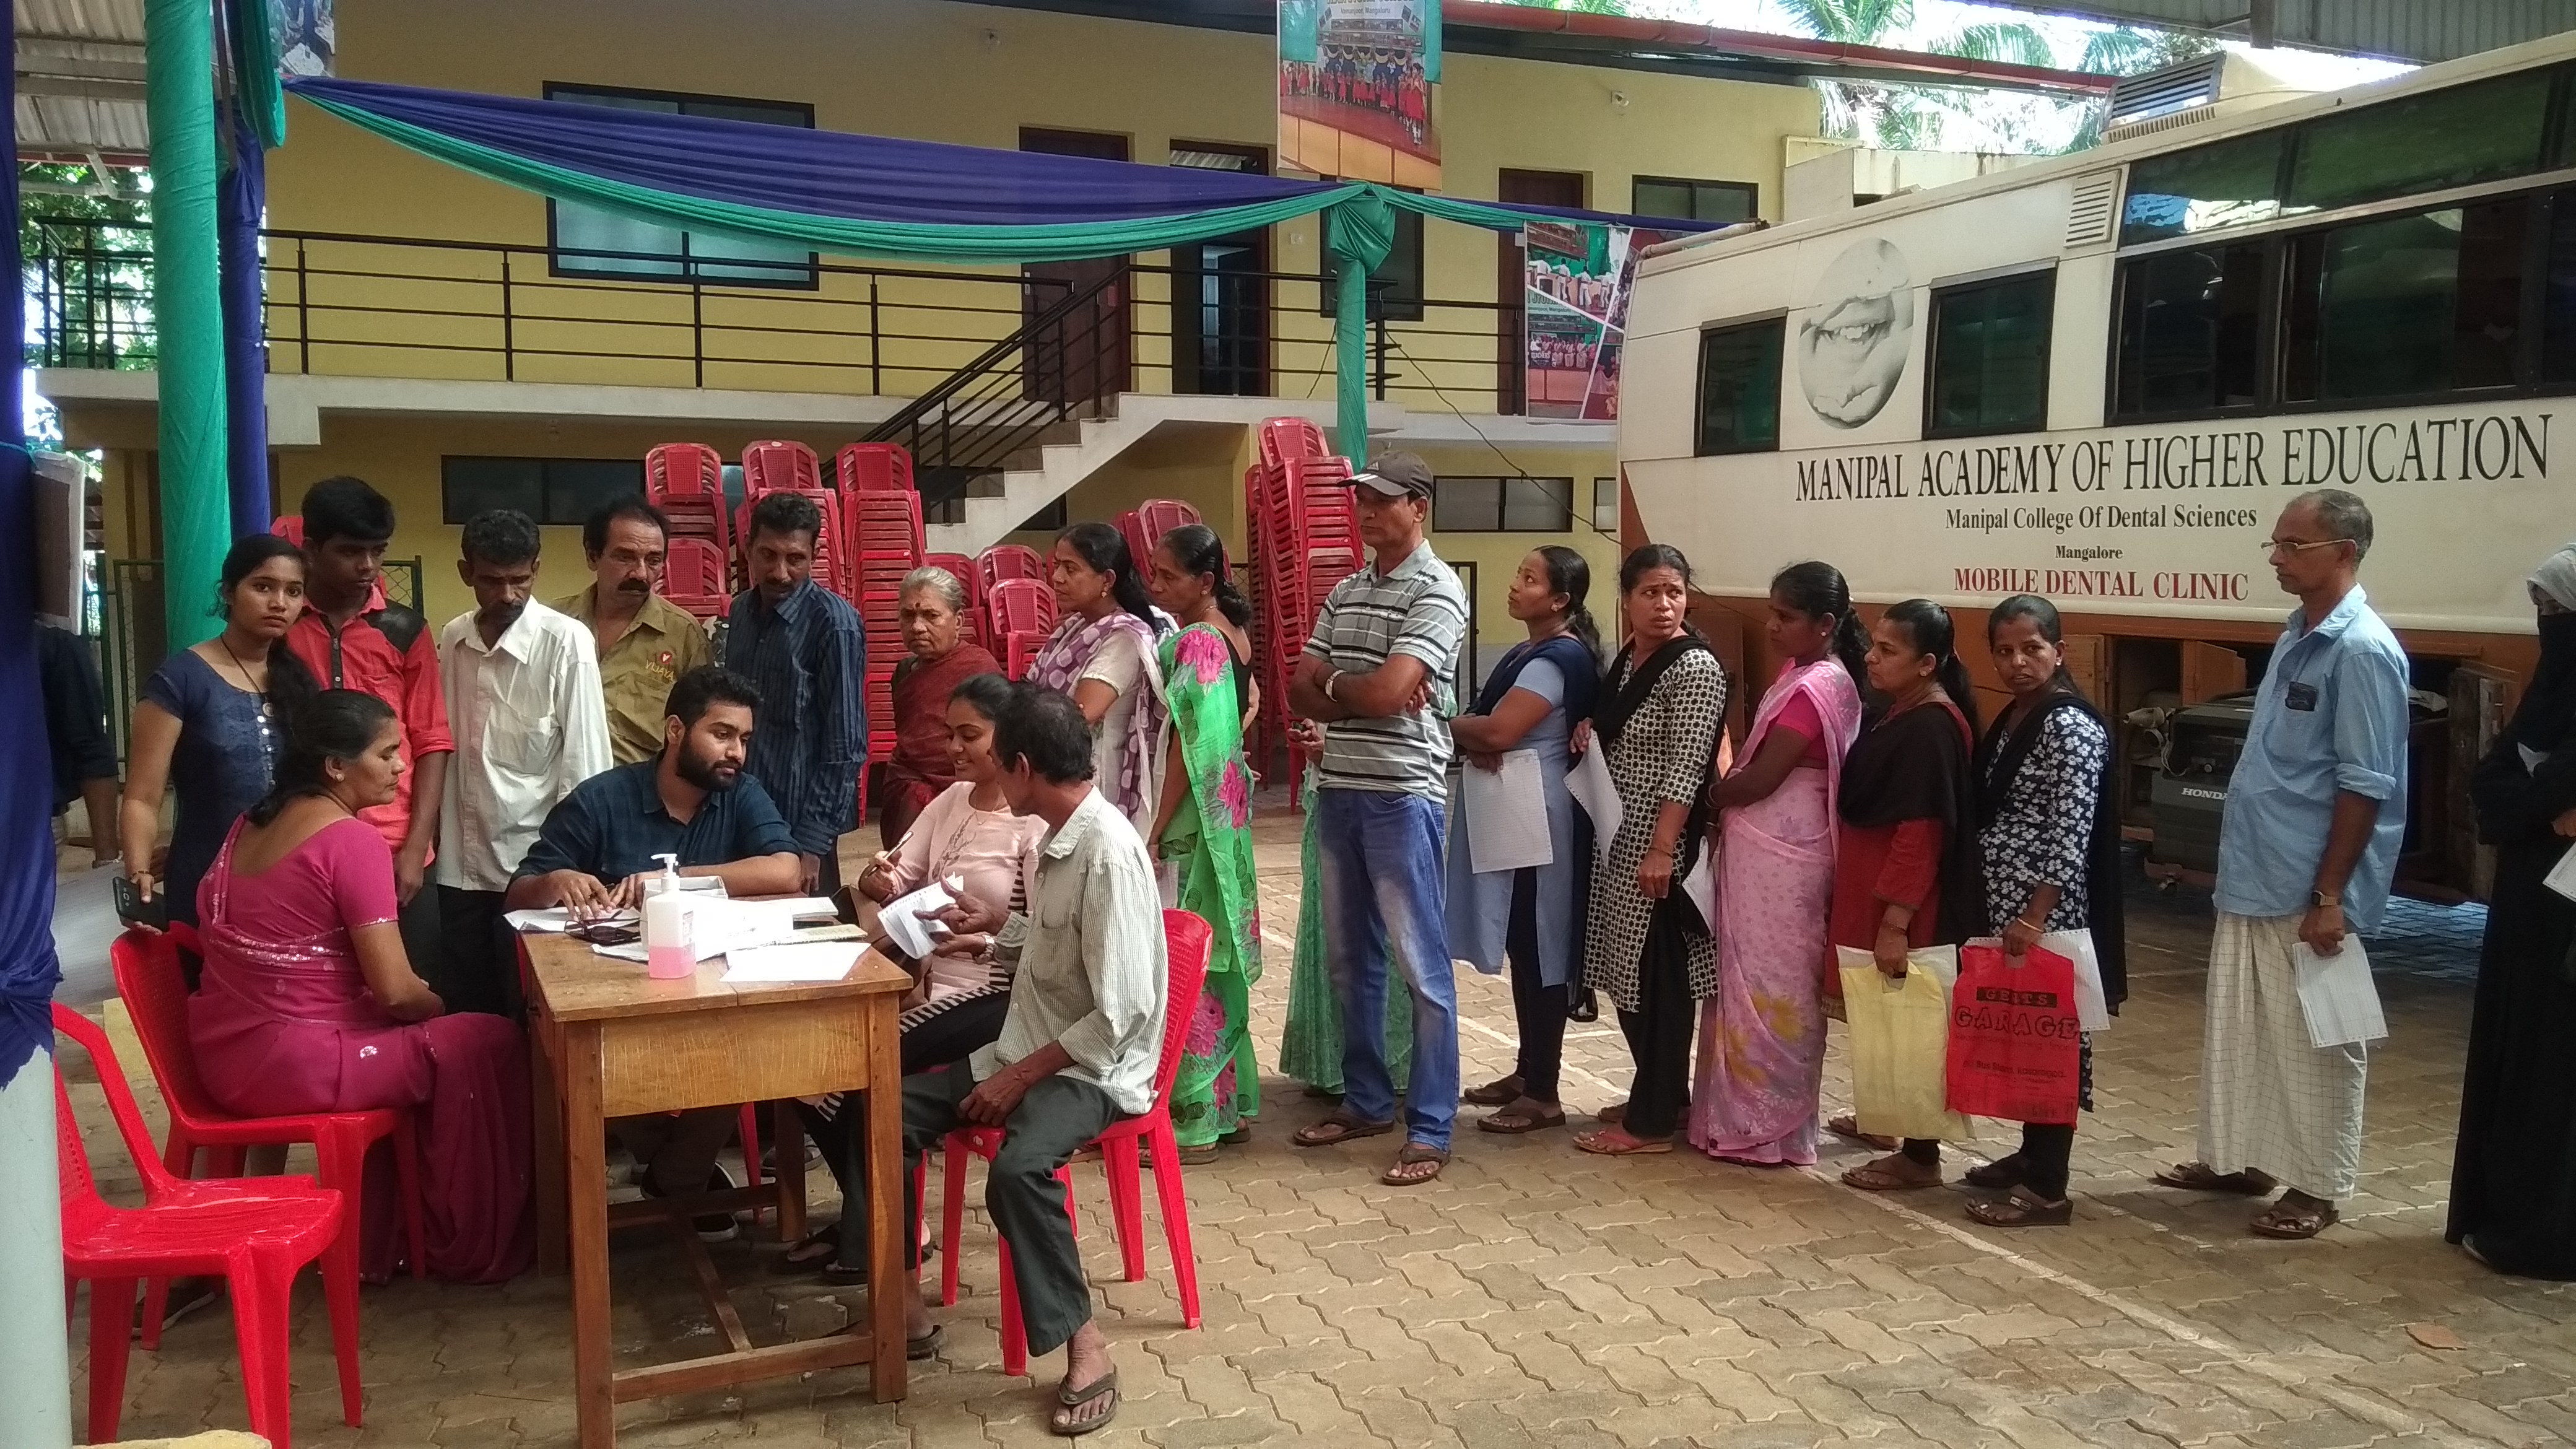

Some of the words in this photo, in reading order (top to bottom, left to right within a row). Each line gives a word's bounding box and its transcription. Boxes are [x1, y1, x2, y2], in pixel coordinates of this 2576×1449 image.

[1795, 454, 1909, 502] MANIPAL
[1918, 444, 2066, 497] ACADEMY
[2072, 440, 2114, 492] OF
[2123, 432, 2269, 490] HIGHER
[2281, 414, 2554, 485] EDUCATION
[1946, 508, 2008, 535] Manipal
[2013, 507, 2074, 535] College
[2079, 505, 2104, 528] Of
[2107, 504, 2167, 528] Dental
[2174, 503, 2257, 527] Sciences
[2055, 545, 2123, 562] Mangalore
[1954, 567, 2039, 593] MOBILE
[2045, 570, 2144, 597] DENTAL
[2153, 572, 2248, 601] CLINIC
[645, 659, 674, 681] VIJAYA
[1954, 1005, 2081, 1040] GARAGE
